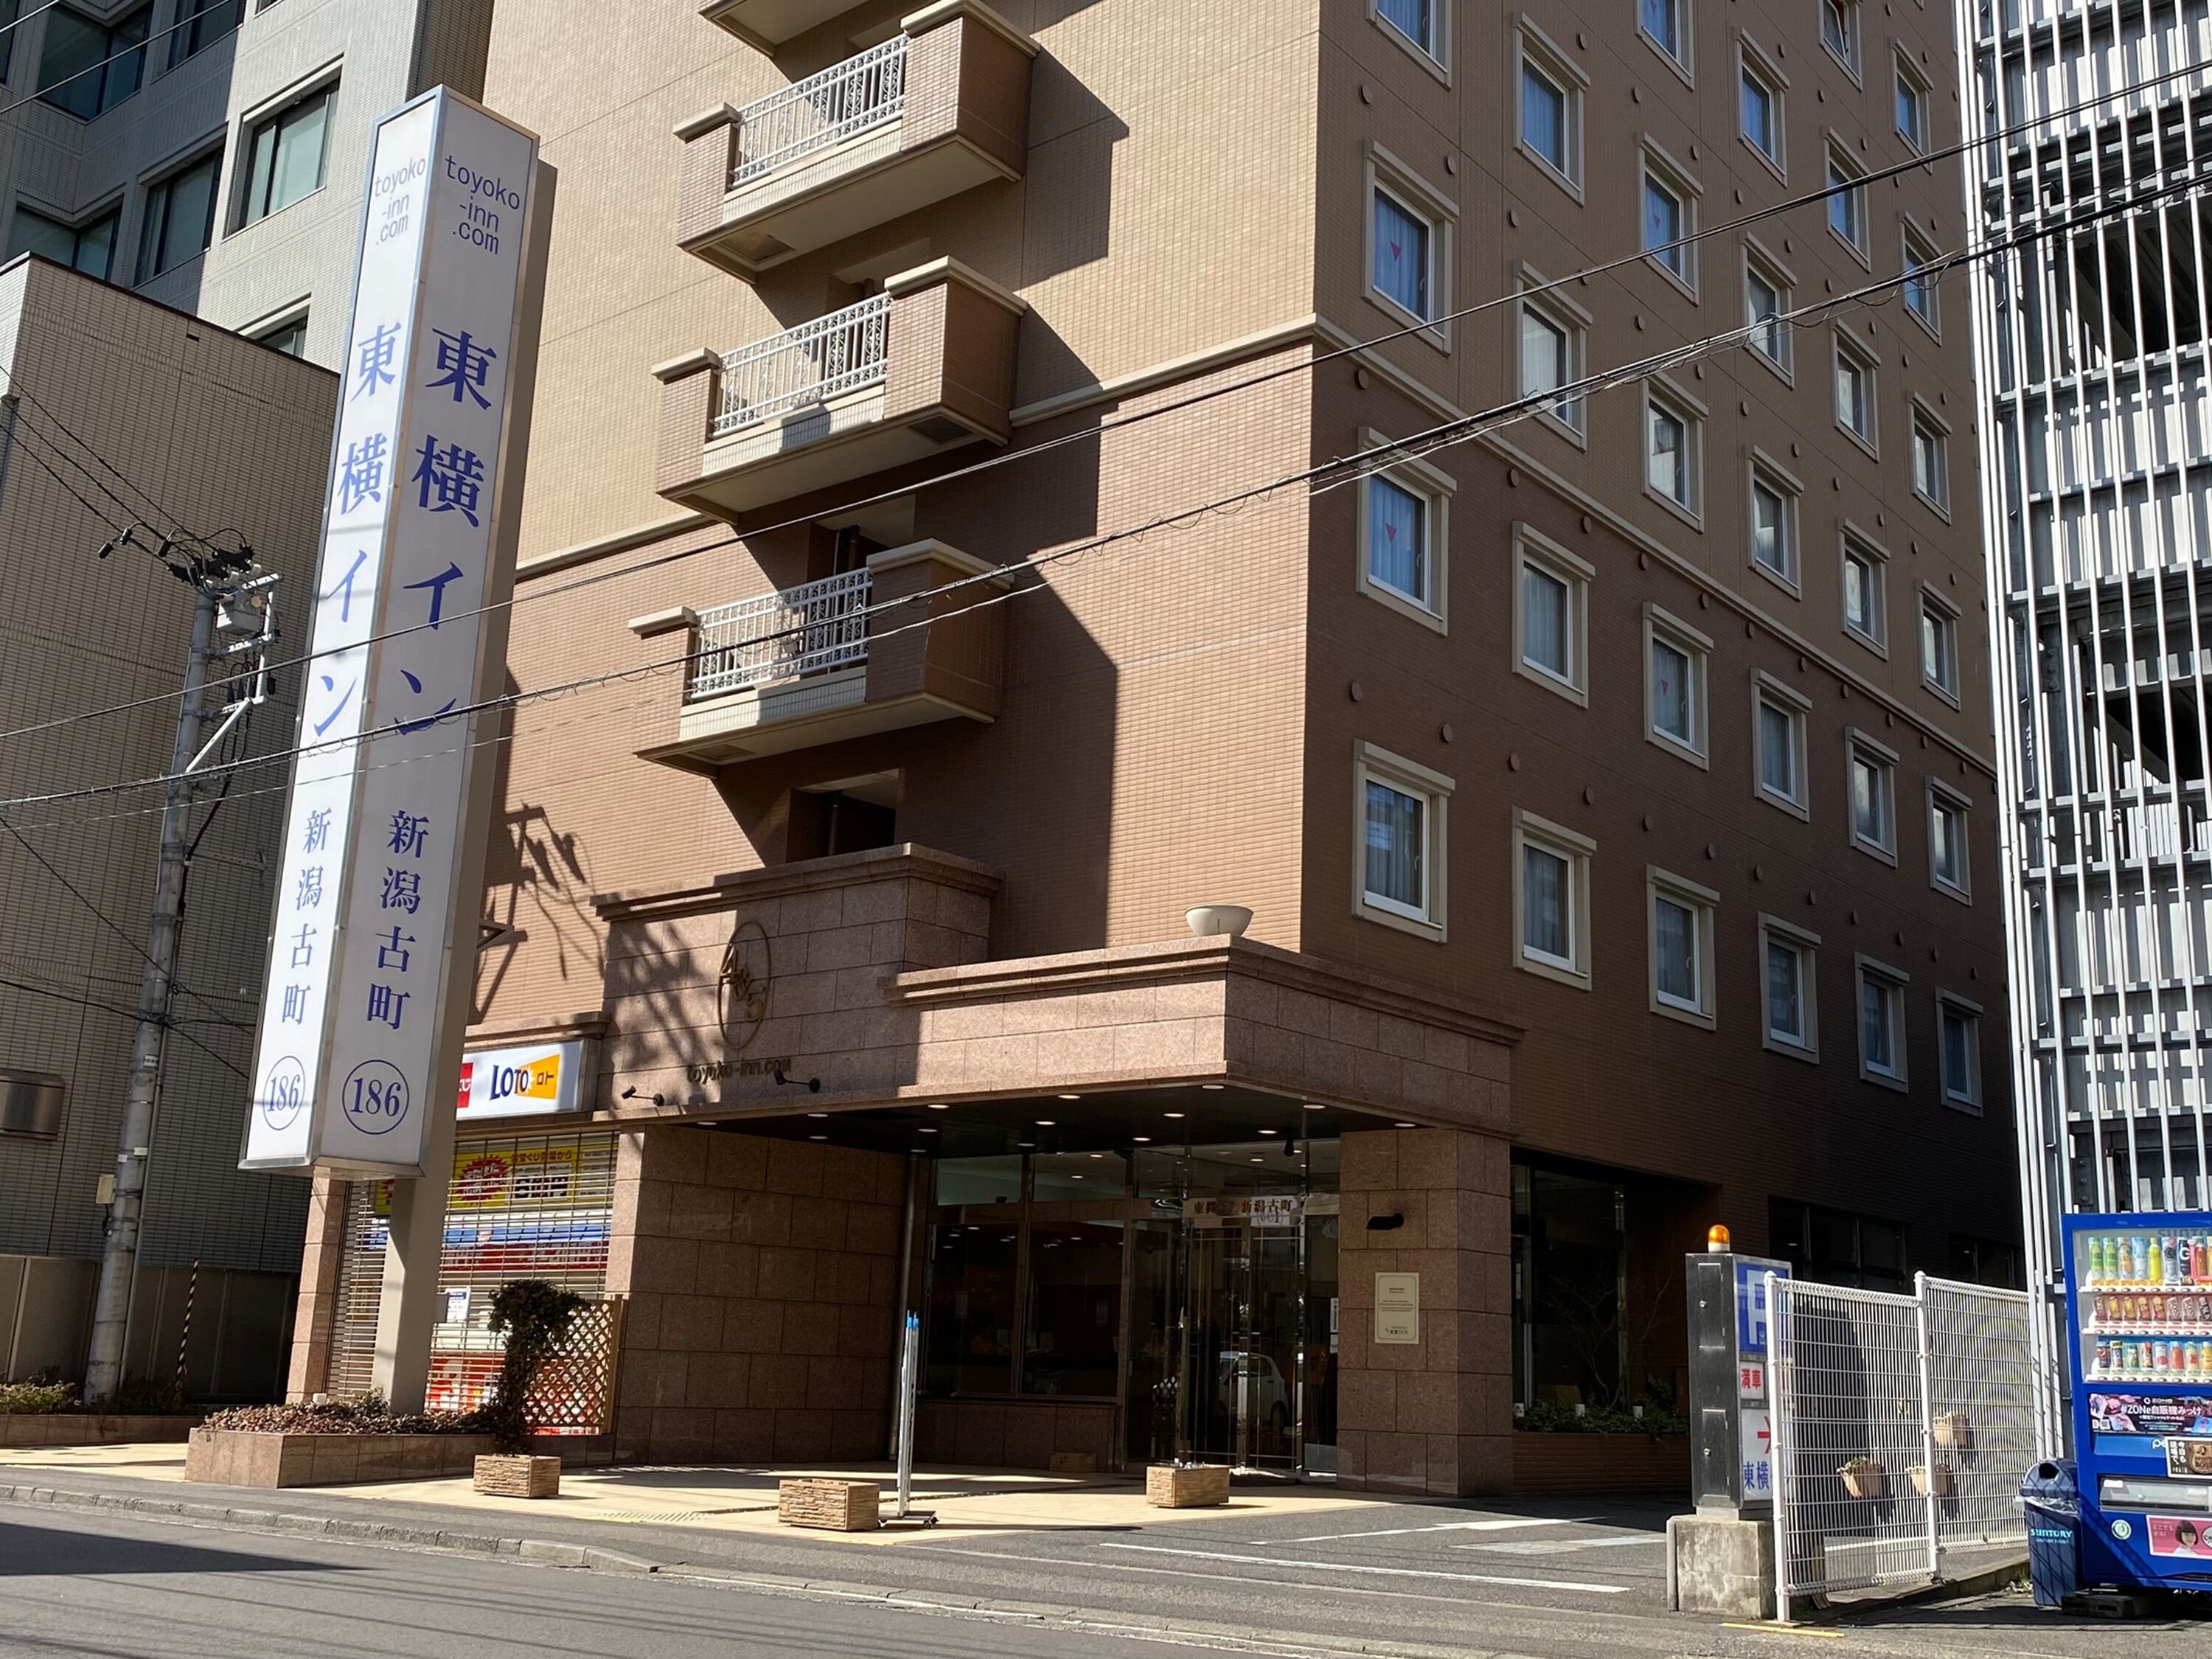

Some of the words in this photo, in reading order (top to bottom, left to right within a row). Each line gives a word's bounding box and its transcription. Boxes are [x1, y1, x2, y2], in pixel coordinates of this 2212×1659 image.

[375, 158, 426, 198] toyoko
[445, 155, 520, 209] toyoko
[381, 195, 410, 220] -inn
[459, 195, 499, 232] -inn
[376, 215, 409, 246] .com
[453, 222, 499, 255] .com
[313, 321, 402, 737] 東横イン
[394, 327, 497, 736] 東横イン
[282, 807, 333, 1026] 新潟古町
[366, 810, 430, 1031] 新潟古町
[267, 1074, 301, 1112] 186
[349, 1077, 402, 1117] 186
[488, 1064, 529, 1101] LOTO
[536, 1070, 554, 1085] ロト
[1741, 1368, 1761, 1389] 満車
[1742, 1461, 1773, 1490] 東横
[2030, 1528, 2073, 1538] SUNTORY
